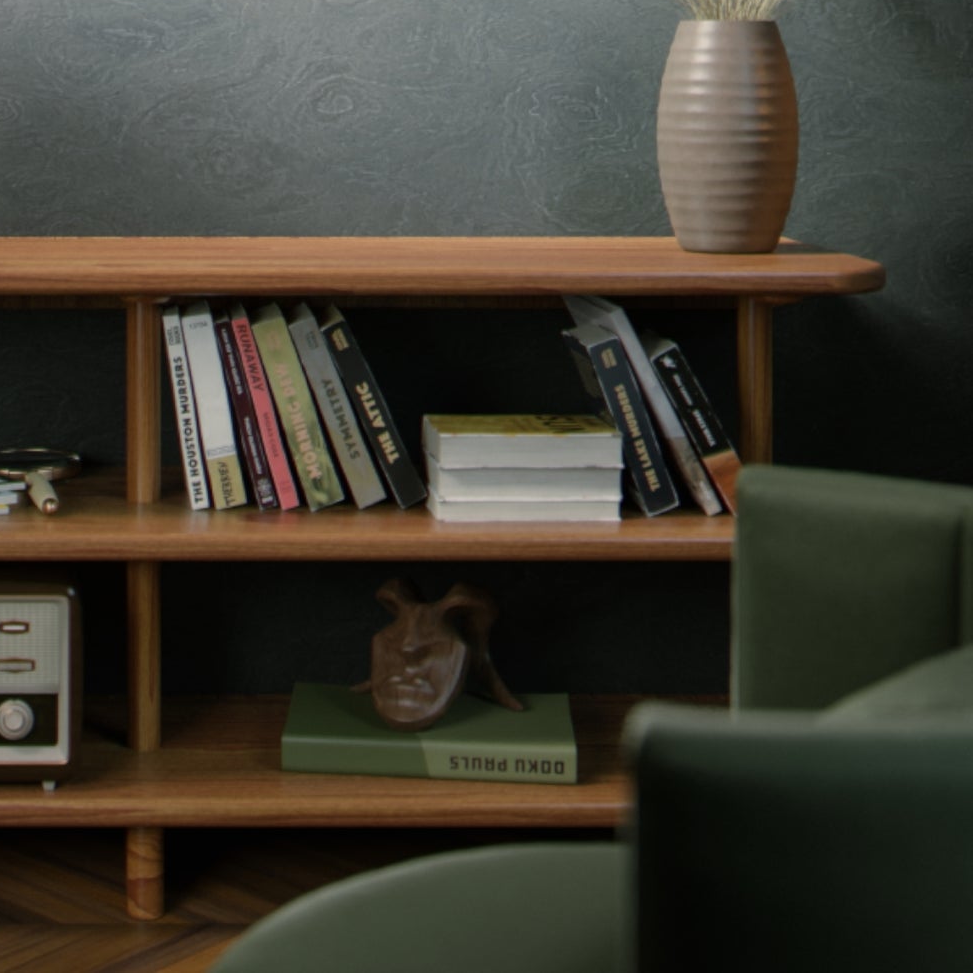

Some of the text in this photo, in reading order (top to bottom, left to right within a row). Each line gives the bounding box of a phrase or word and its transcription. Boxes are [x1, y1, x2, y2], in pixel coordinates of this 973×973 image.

[172, 357, 190, 414] MURDERS
[236, 323, 265, 392] RUNAWAY
[182, 418, 199, 476] HOUSTON
[273, 362, 323, 480] MORNING DEW
[321, 377, 361, 461] SYMMETRY
[354, 381, 401, 464] THE ATTIC
[613, 384, 661, 491] THE LAKE MURDERS
[192, 481, 204, 503] THE
[515, 758, 565, 775] DOKU
